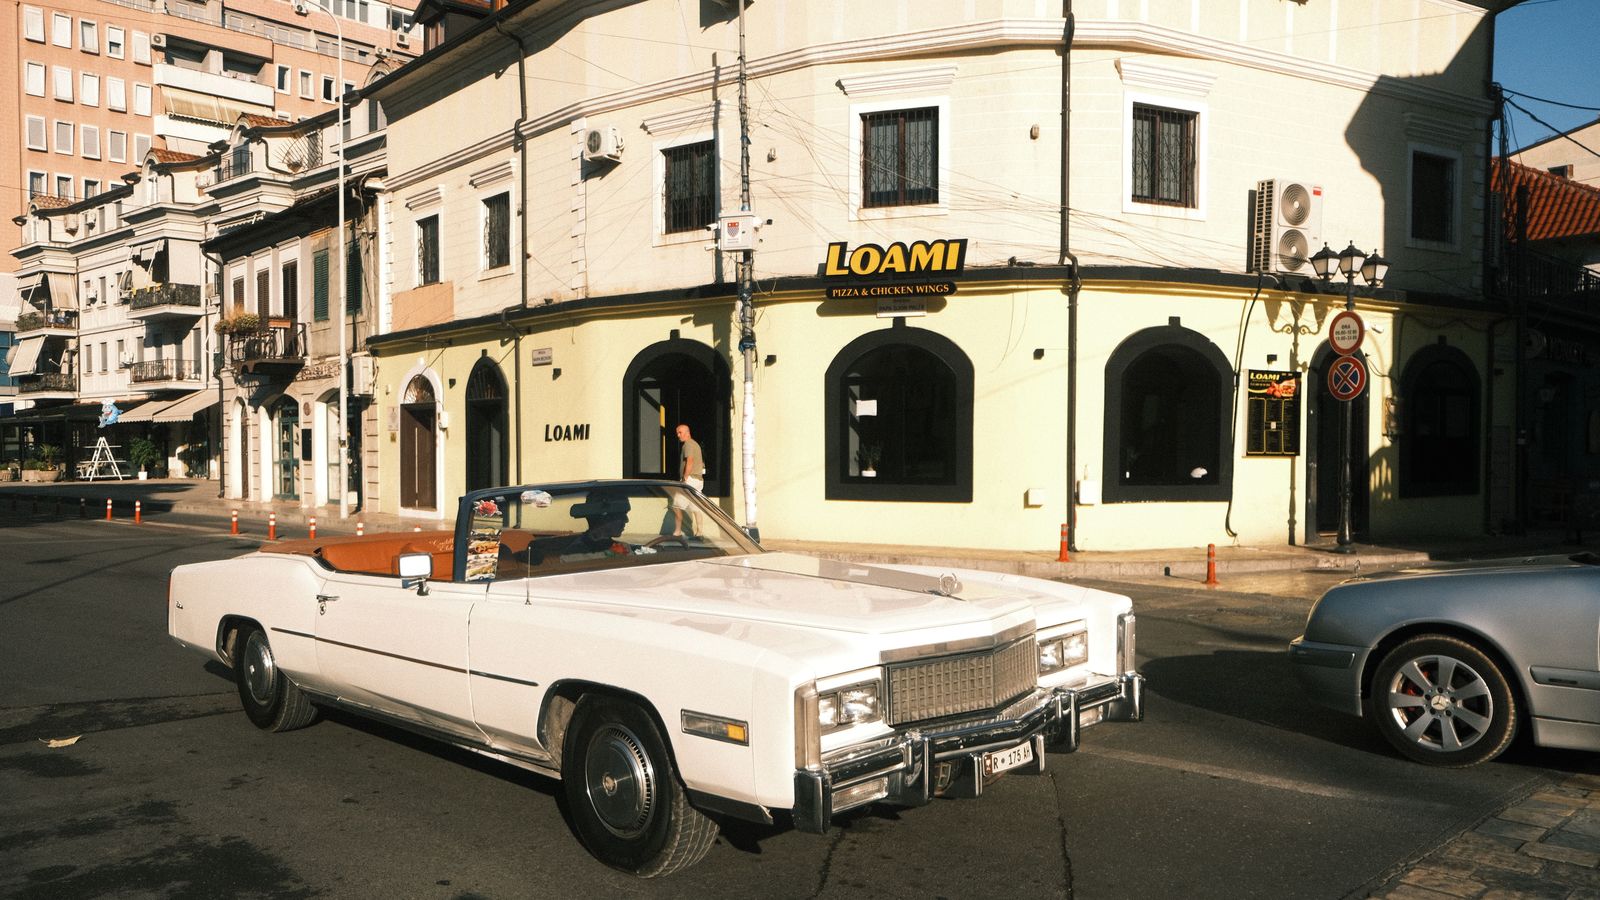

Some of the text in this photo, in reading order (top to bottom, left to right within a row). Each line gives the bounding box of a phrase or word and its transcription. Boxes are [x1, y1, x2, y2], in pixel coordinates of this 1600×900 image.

[825, 242, 961, 276] LOAMI
[832, 284, 949, 297] PIZZA & CHICKEN WINGS
[1250, 372, 1280, 380] LOAMI
[544, 424, 590, 442] LOAMI
[994, 757, 998, 770] R
[1008, 750, 1022, 765] 175
